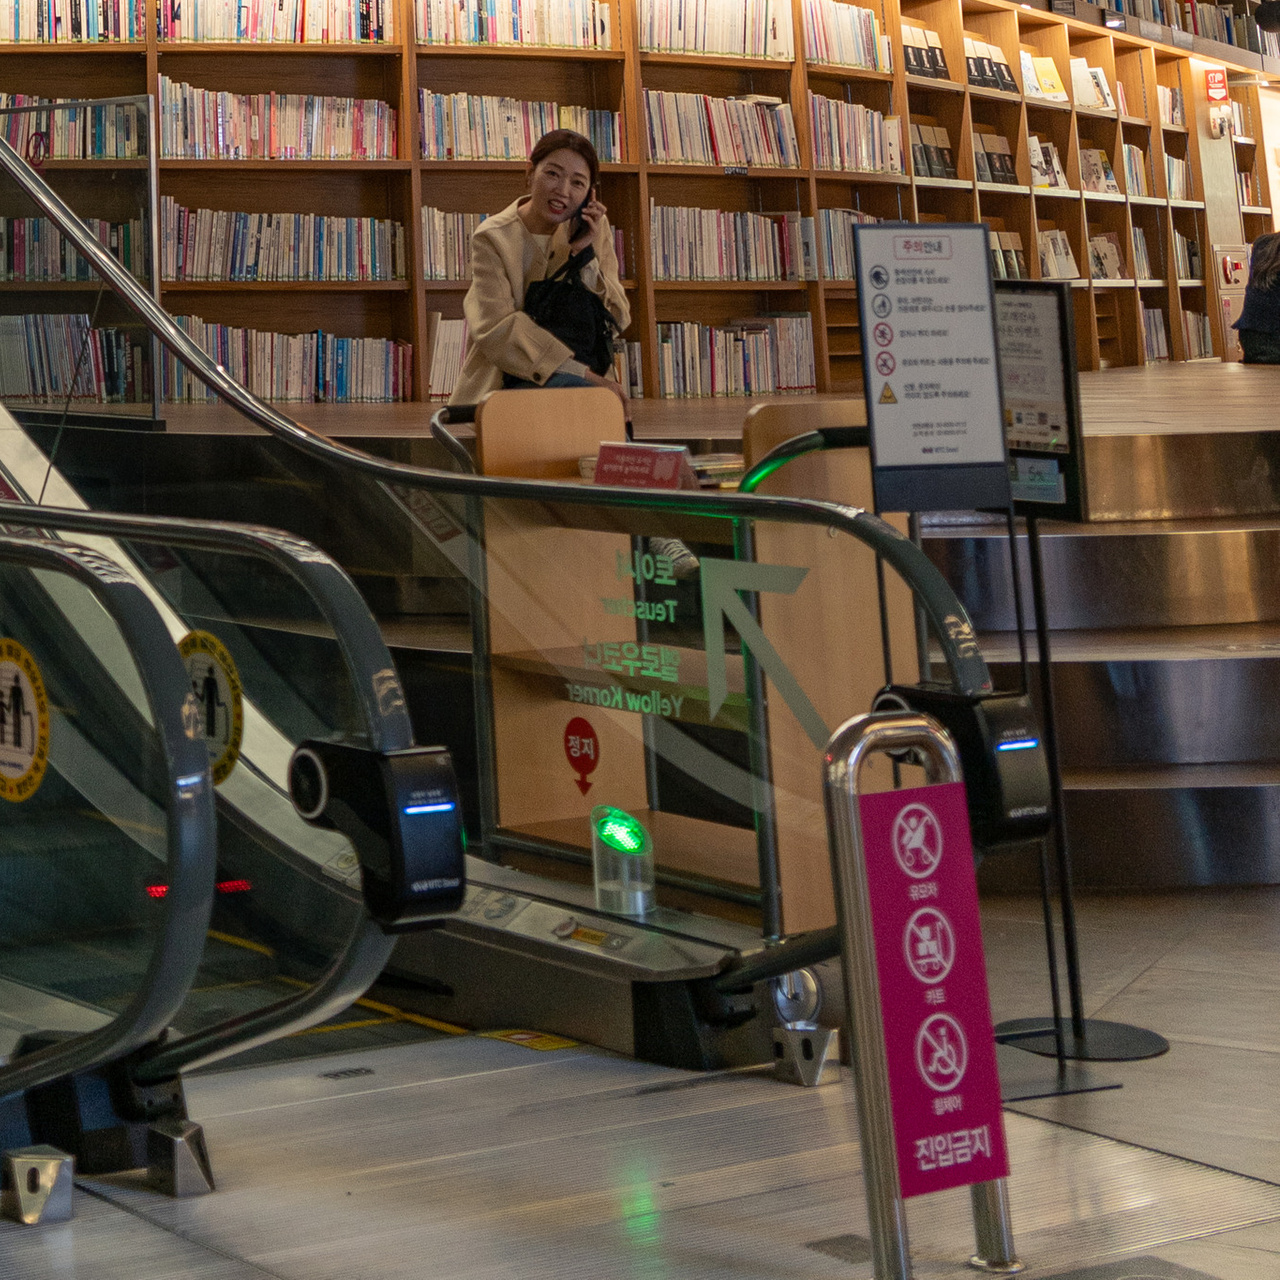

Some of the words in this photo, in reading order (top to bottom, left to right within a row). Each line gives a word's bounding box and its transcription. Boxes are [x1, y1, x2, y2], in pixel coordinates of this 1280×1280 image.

[568, 734, 595, 760] 정지
[908, 881, 939, 901] 유모차
[925, 988, 946, 1005] 카트
[932, 1095, 963, 1116] 휠체어
[913, 1124, 991, 1172] 진입금지
